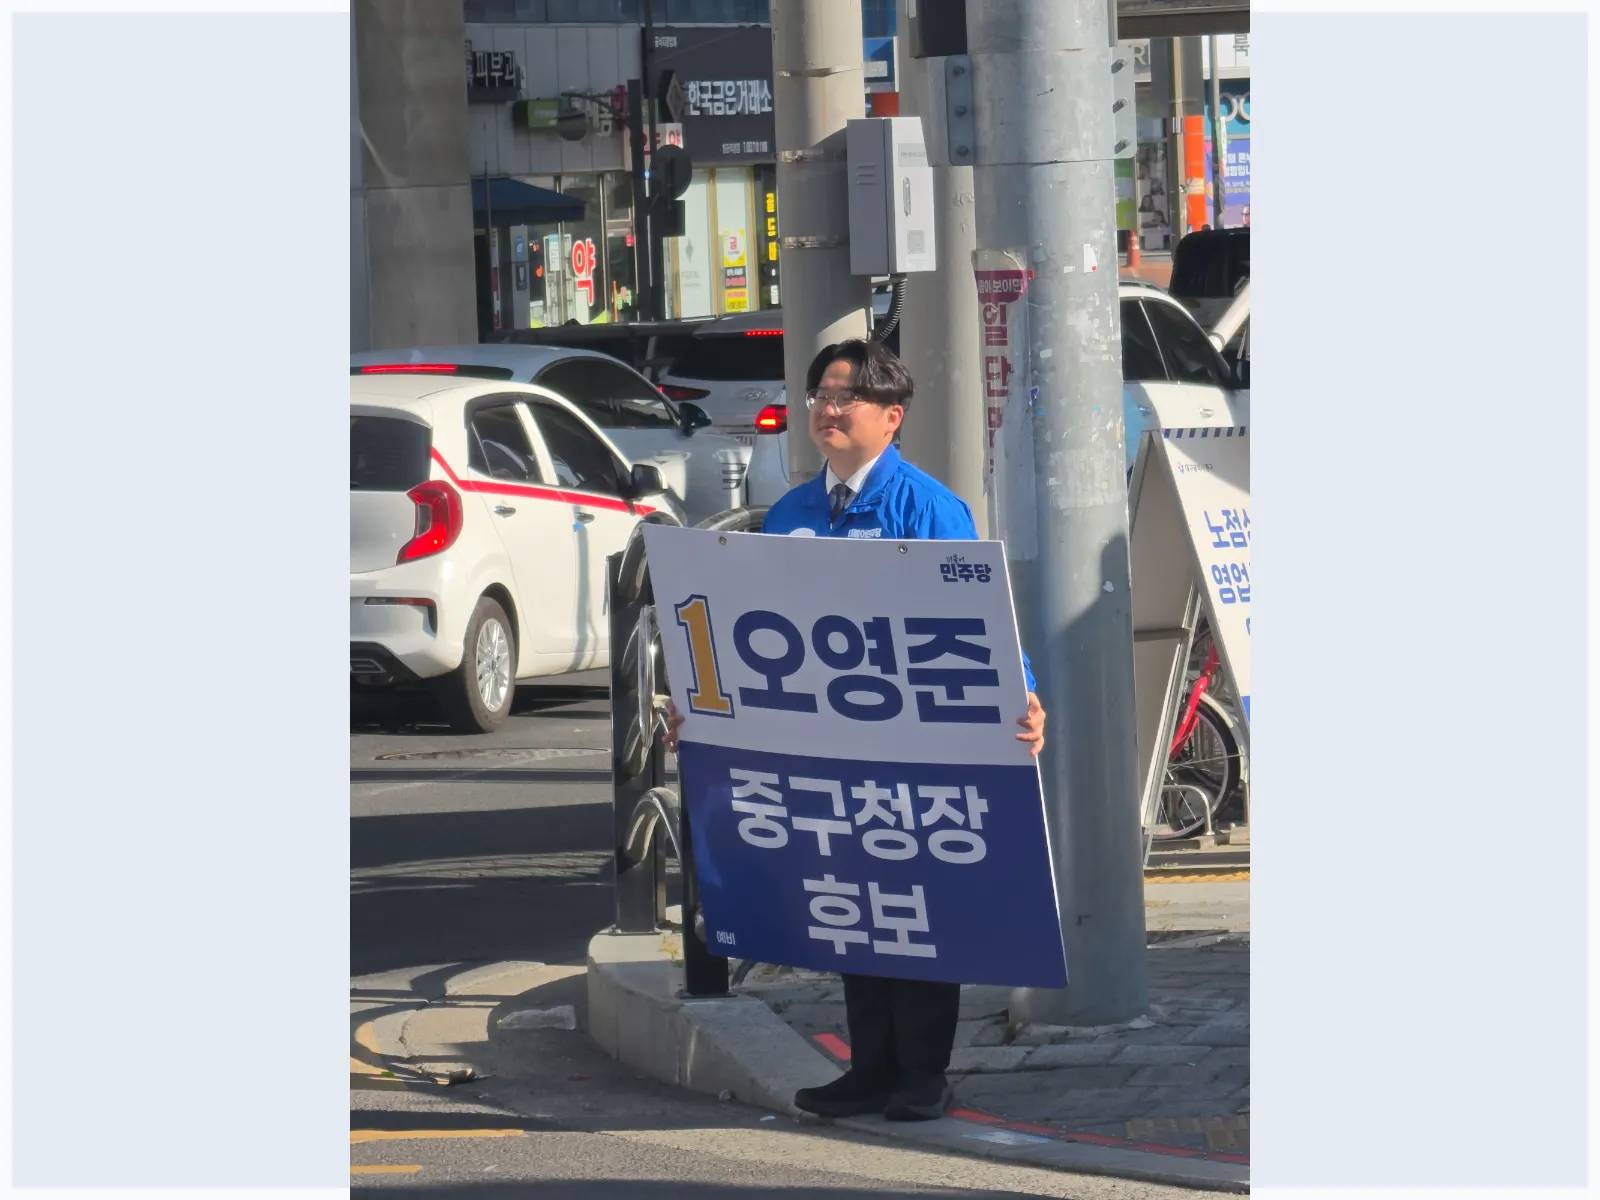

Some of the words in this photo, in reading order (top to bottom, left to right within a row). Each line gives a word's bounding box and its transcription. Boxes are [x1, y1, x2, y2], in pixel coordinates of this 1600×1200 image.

[688, 80, 773, 116] 한국금은거래소
[572, 238, 596, 307] 약
[939, 563, 992, 583] 민주당
[674, 594, 735, 719] 1
[733, 609, 1001, 723] 오영준
[729, 767, 988, 864] 중구청장
[802, 873, 937, 958] 후보
